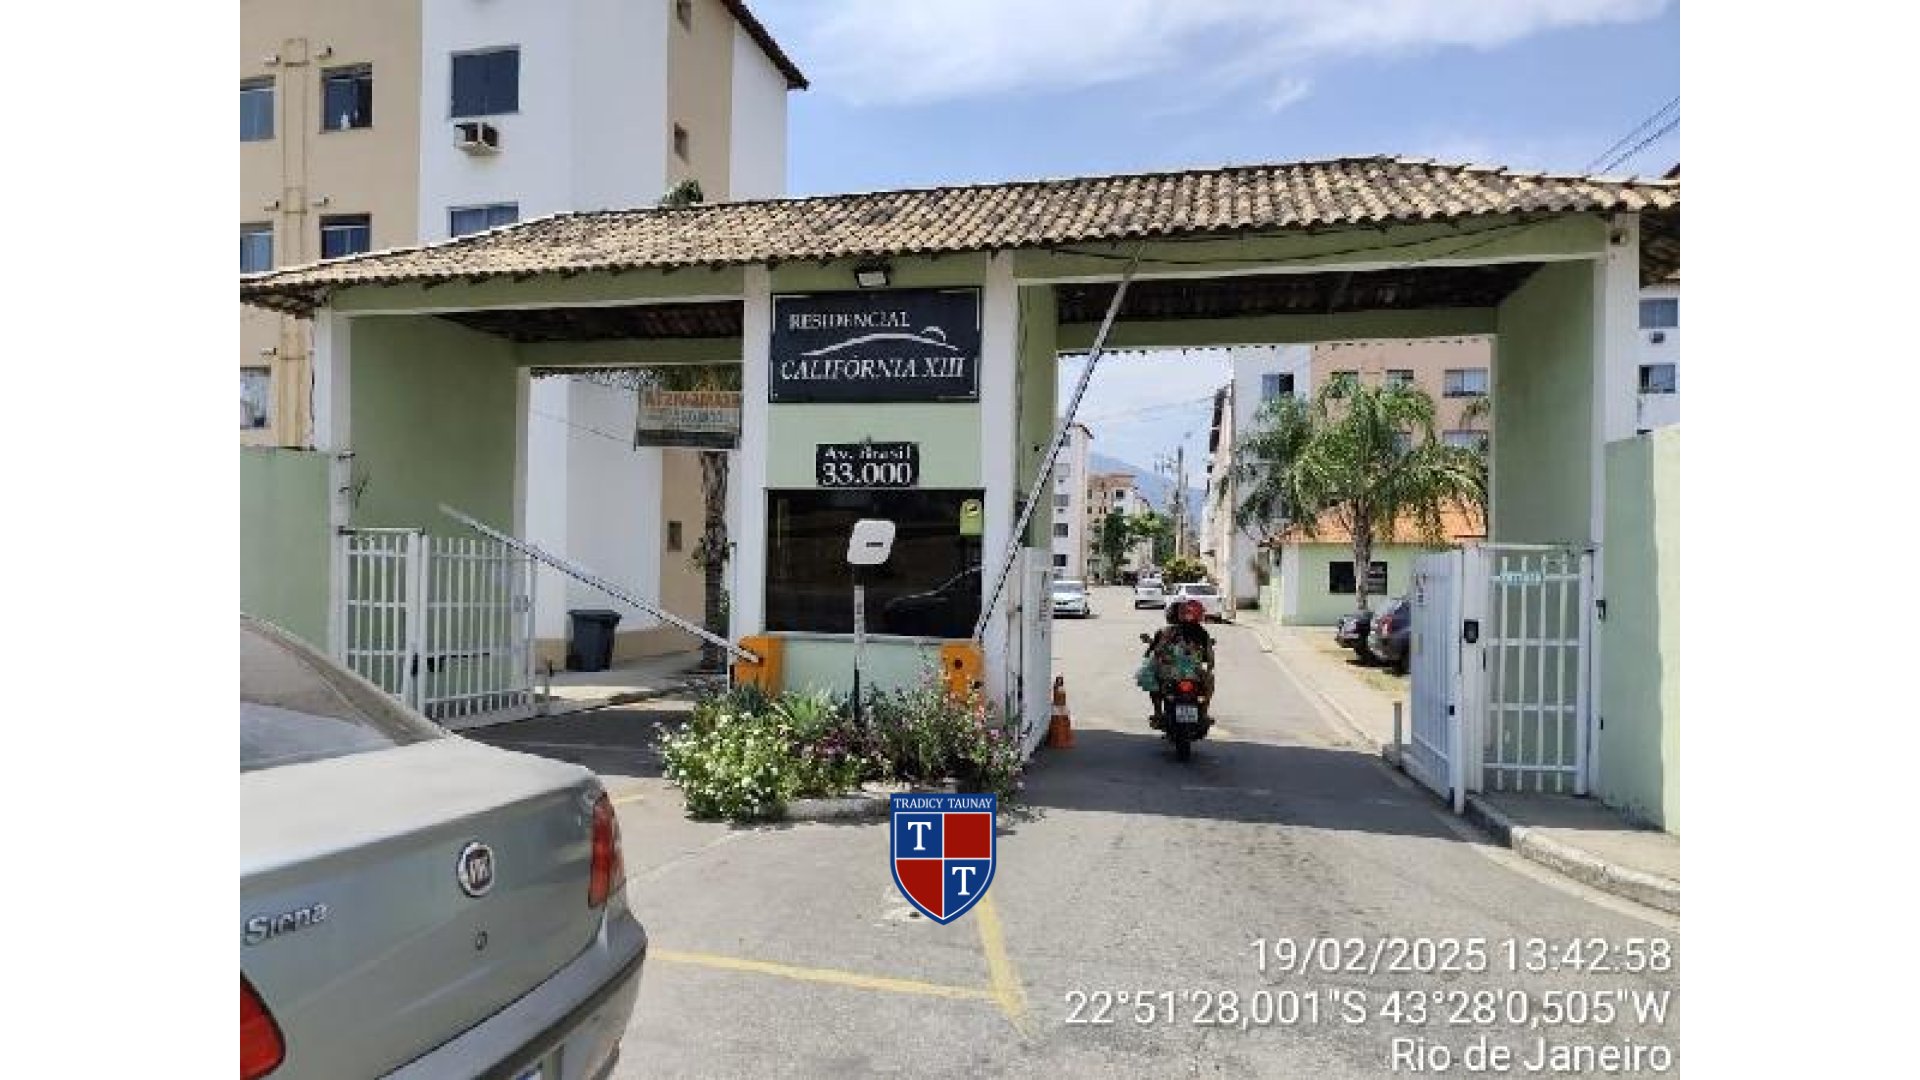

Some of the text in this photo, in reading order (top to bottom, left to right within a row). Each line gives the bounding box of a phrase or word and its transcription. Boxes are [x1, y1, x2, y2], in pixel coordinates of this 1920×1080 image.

[788, 311, 911, 330] RESIDENCIAL
[780, 355, 966, 380] CALIFÓRNIA XIII
[825, 444, 910, 459] Av. Brasil
[822, 462, 912, 485] 33.000
[244, 902, 327, 946] Siena
